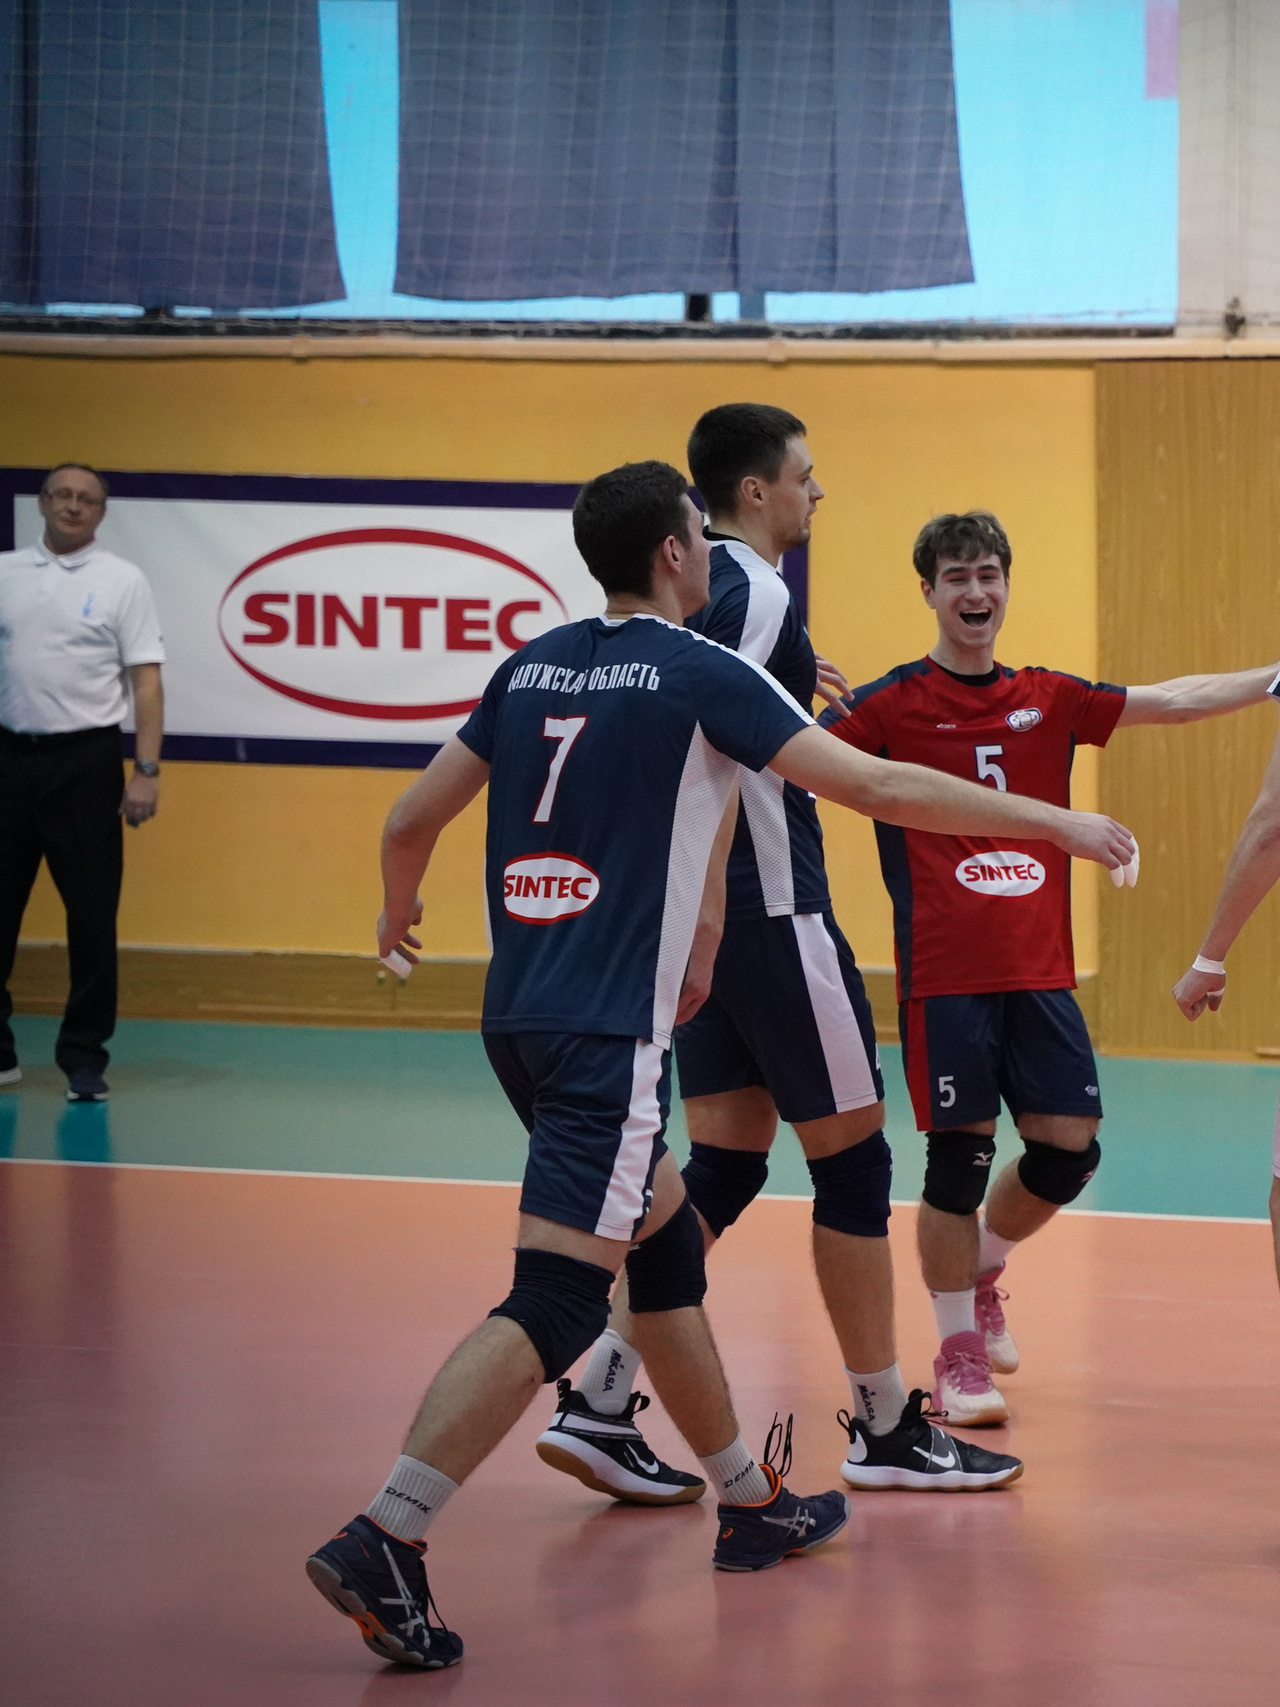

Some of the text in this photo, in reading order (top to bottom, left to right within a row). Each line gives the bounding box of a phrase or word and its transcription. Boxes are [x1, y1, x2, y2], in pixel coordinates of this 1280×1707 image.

[242, 592, 541, 653] SINTEC
[588, 662, 660, 691] ОБЛАСТЬ
[532, 715, 588, 824] 7
[974, 744, 1007, 792] 5
[504, 875, 592, 900] SINTEC
[964, 863, 1039, 883] SINTEC
[938, 1076, 957, 1108] 5
